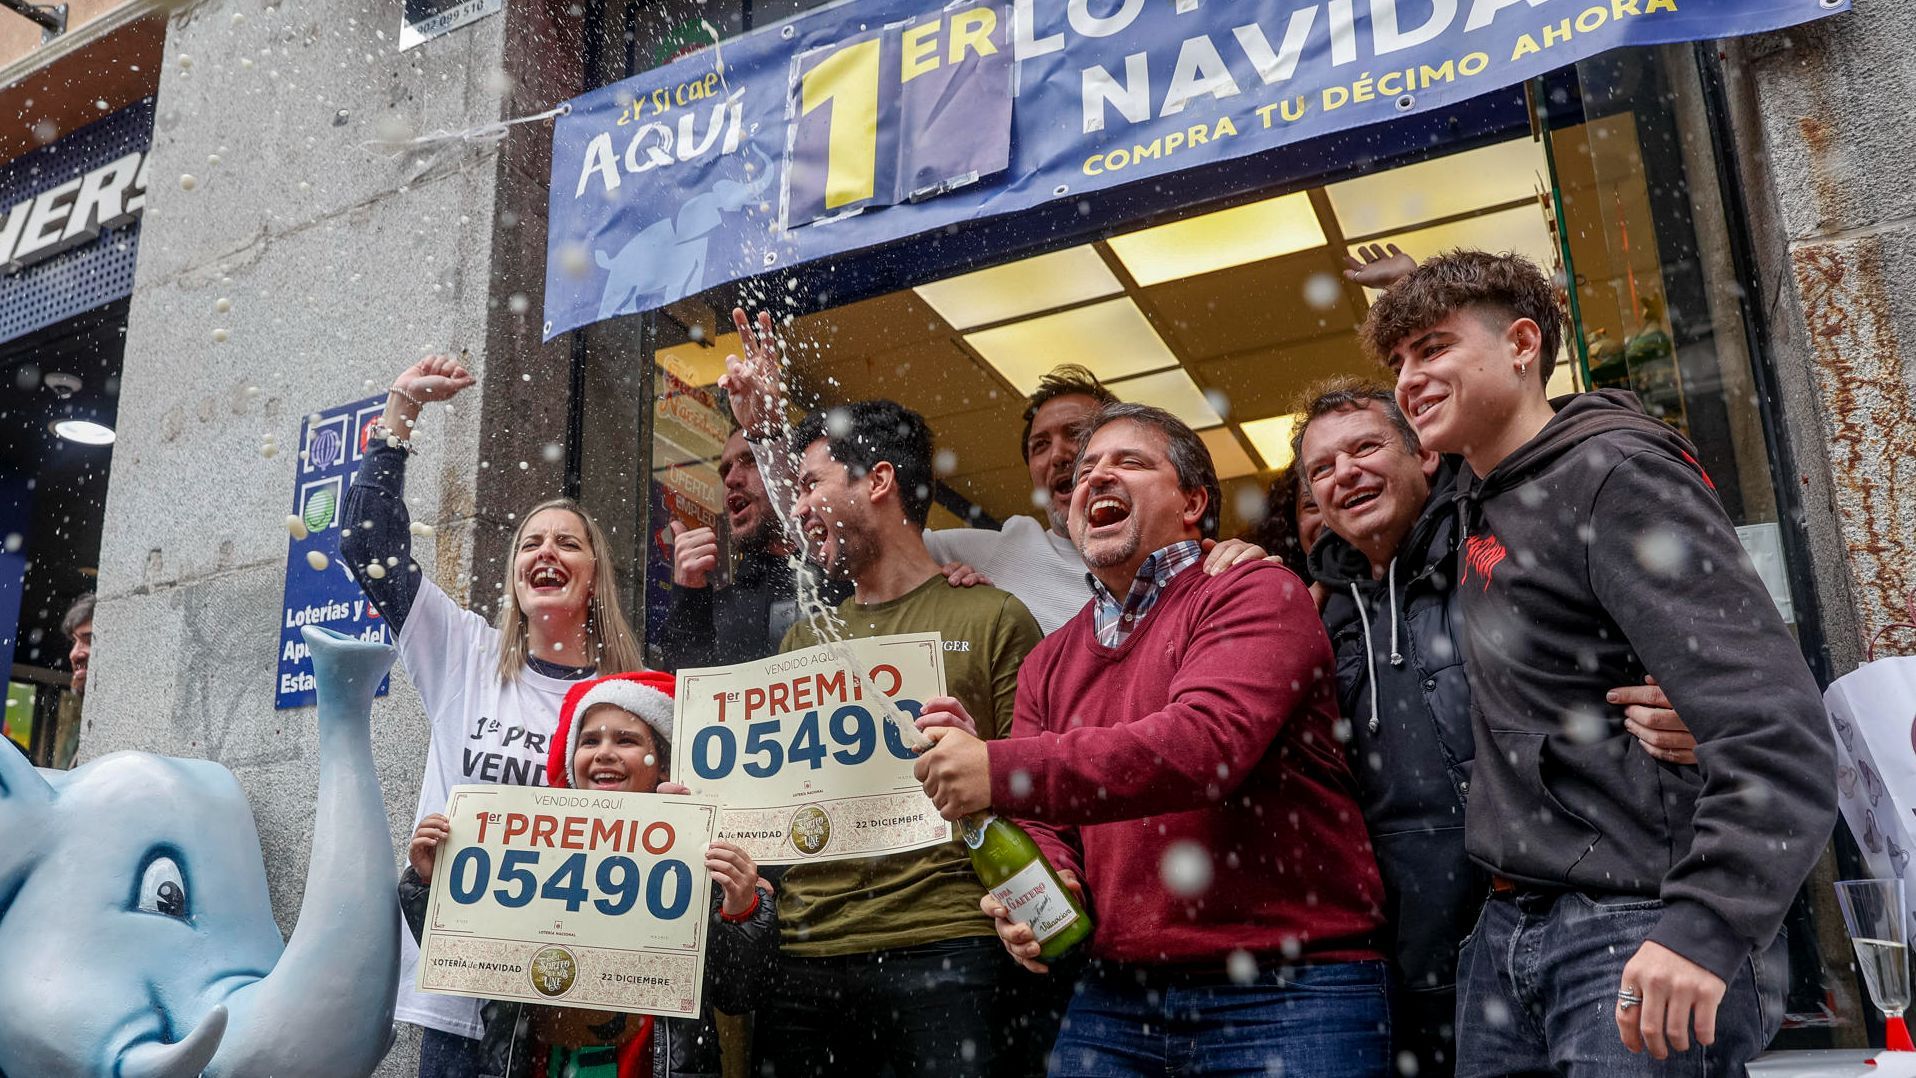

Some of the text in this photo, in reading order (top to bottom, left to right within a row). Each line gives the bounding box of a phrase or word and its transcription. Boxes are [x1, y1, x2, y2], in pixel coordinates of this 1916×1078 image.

[1083, 117, 1238, 176] COMPRA
[1256, 96, 1305, 131] TU
[1323, 52, 1489, 112] DÉCIMO
[286, 599, 364, 628] Loterías y
[764, 651, 839, 676] VENDIDO AQU
[281, 671, 317, 694] Esta
[713, 664, 903, 722] 1er PREMIO
[691, 699, 924, 780] 05490
[535, 794, 623, 812] VENDIDO AQUÍ
[476, 812, 676, 855] 1er PREMIO
[737, 830, 782, 839] NAVIDAD
[855, 820, 868, 829] 22
[870, 814, 924, 828] DICIEMBRE
[449, 846, 693, 921] 05490
[433, 958, 468, 969] LOTERÍA
[478, 963, 522, 973] NAVIDAD
[601, 973, 614, 982] 22
[616, 974, 670, 986] DICIEMBRE
